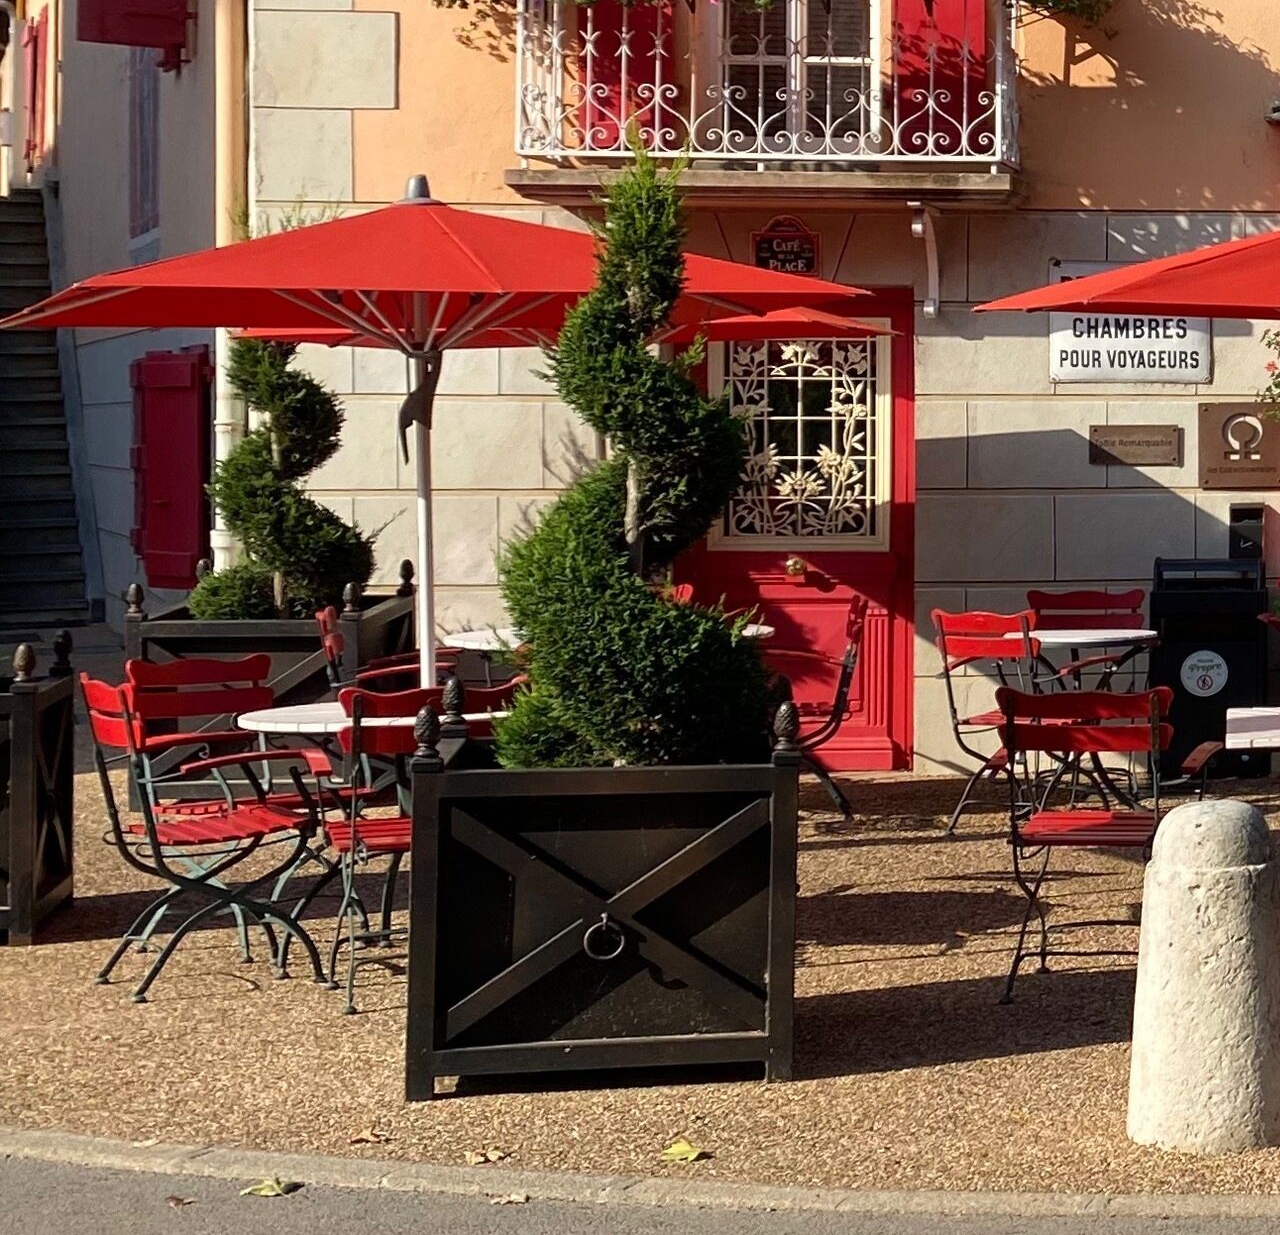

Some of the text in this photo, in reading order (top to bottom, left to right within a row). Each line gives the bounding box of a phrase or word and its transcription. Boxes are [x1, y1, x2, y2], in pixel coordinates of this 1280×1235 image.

[769, 260, 807, 272] PLACE
[1072, 317, 1188, 339] CHAMBRES
[1059, 349, 1200, 370] POUR VOYAGEURS
